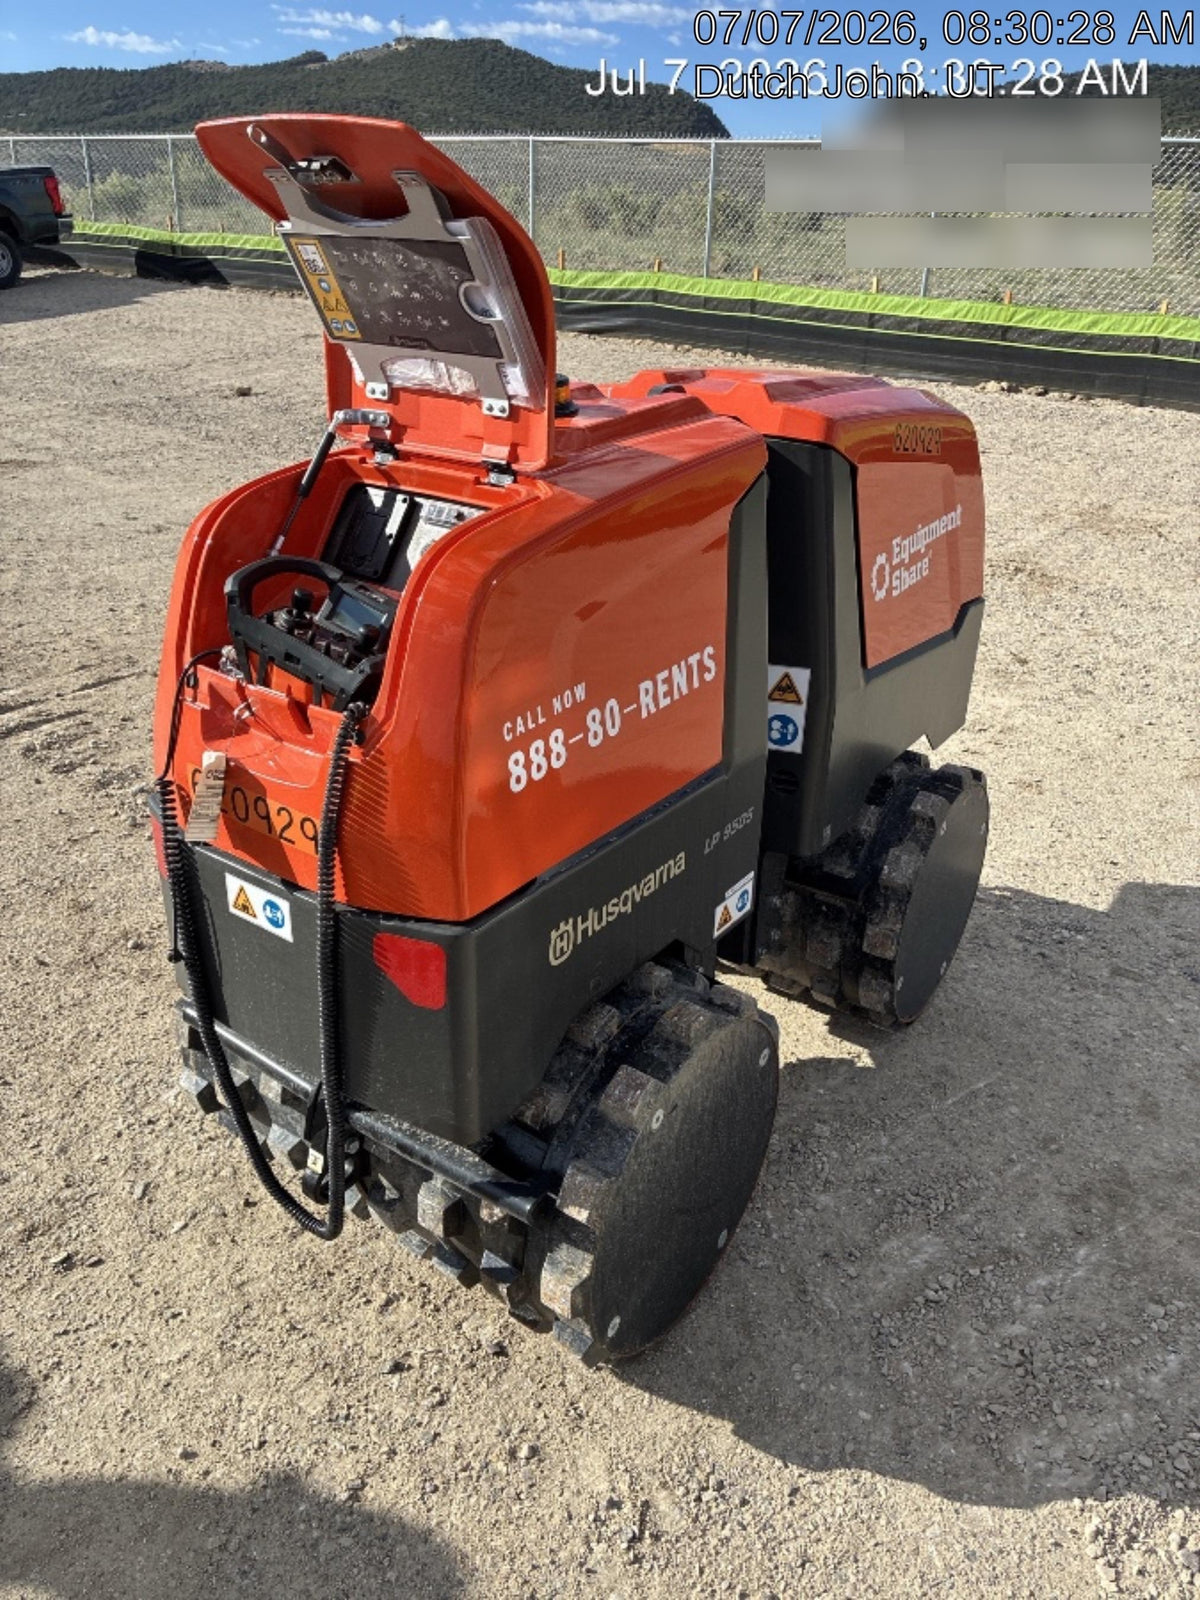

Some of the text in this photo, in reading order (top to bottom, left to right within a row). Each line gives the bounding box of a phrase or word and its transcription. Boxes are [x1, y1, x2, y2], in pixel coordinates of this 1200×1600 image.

[892, 503, 962, 565] Equipment
[892, 557, 929, 597] Share
[503, 682, 587, 742] CALL NOW
[508, 645, 717, 794] 888-80-RENTS
[191, 768, 320, 856] 0929
[704, 831, 721, 854] LP
[577, 851, 686, 945] Husqvarna
